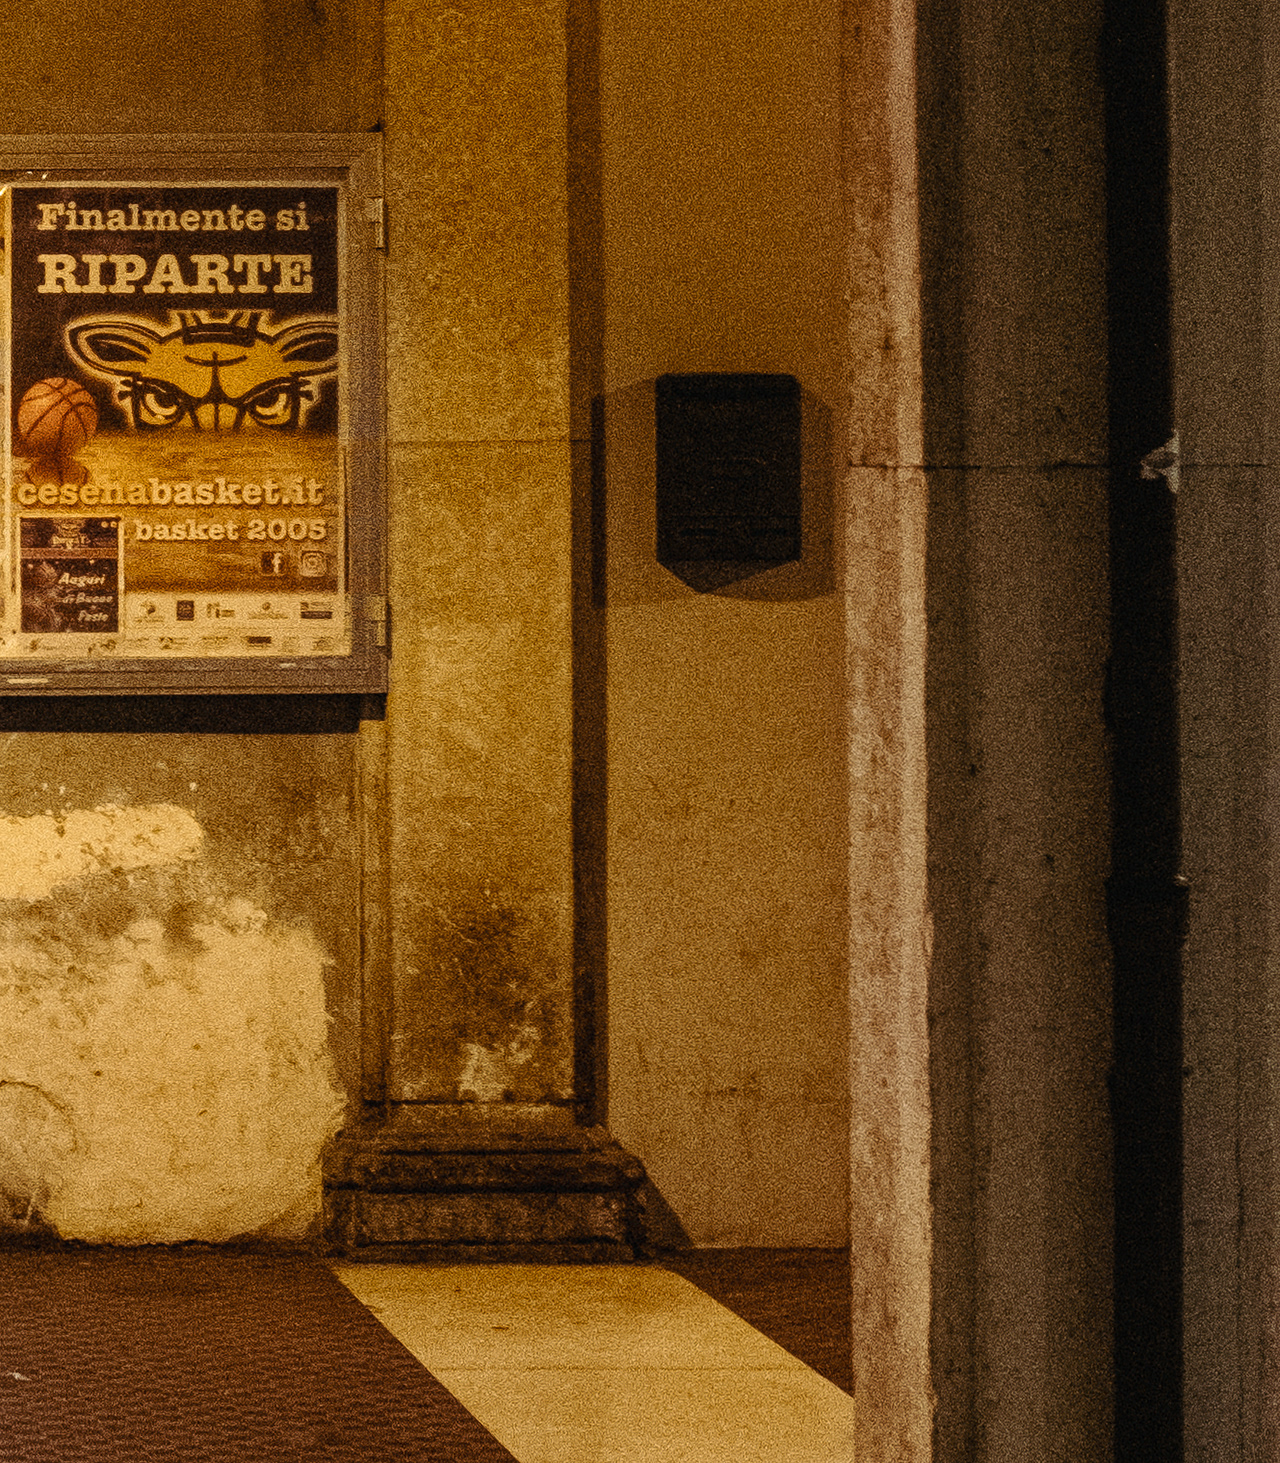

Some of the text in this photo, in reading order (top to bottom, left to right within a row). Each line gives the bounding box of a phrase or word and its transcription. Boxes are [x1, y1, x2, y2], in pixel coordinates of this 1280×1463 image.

[37, 201, 309, 232] Finalmente si
[37, 254, 314, 294] RIPARTE
[17, 476, 325, 507] cesenabasket.it
[134, 518, 328, 542] basket 2005
[58, 572, 107, 588] Auguri
